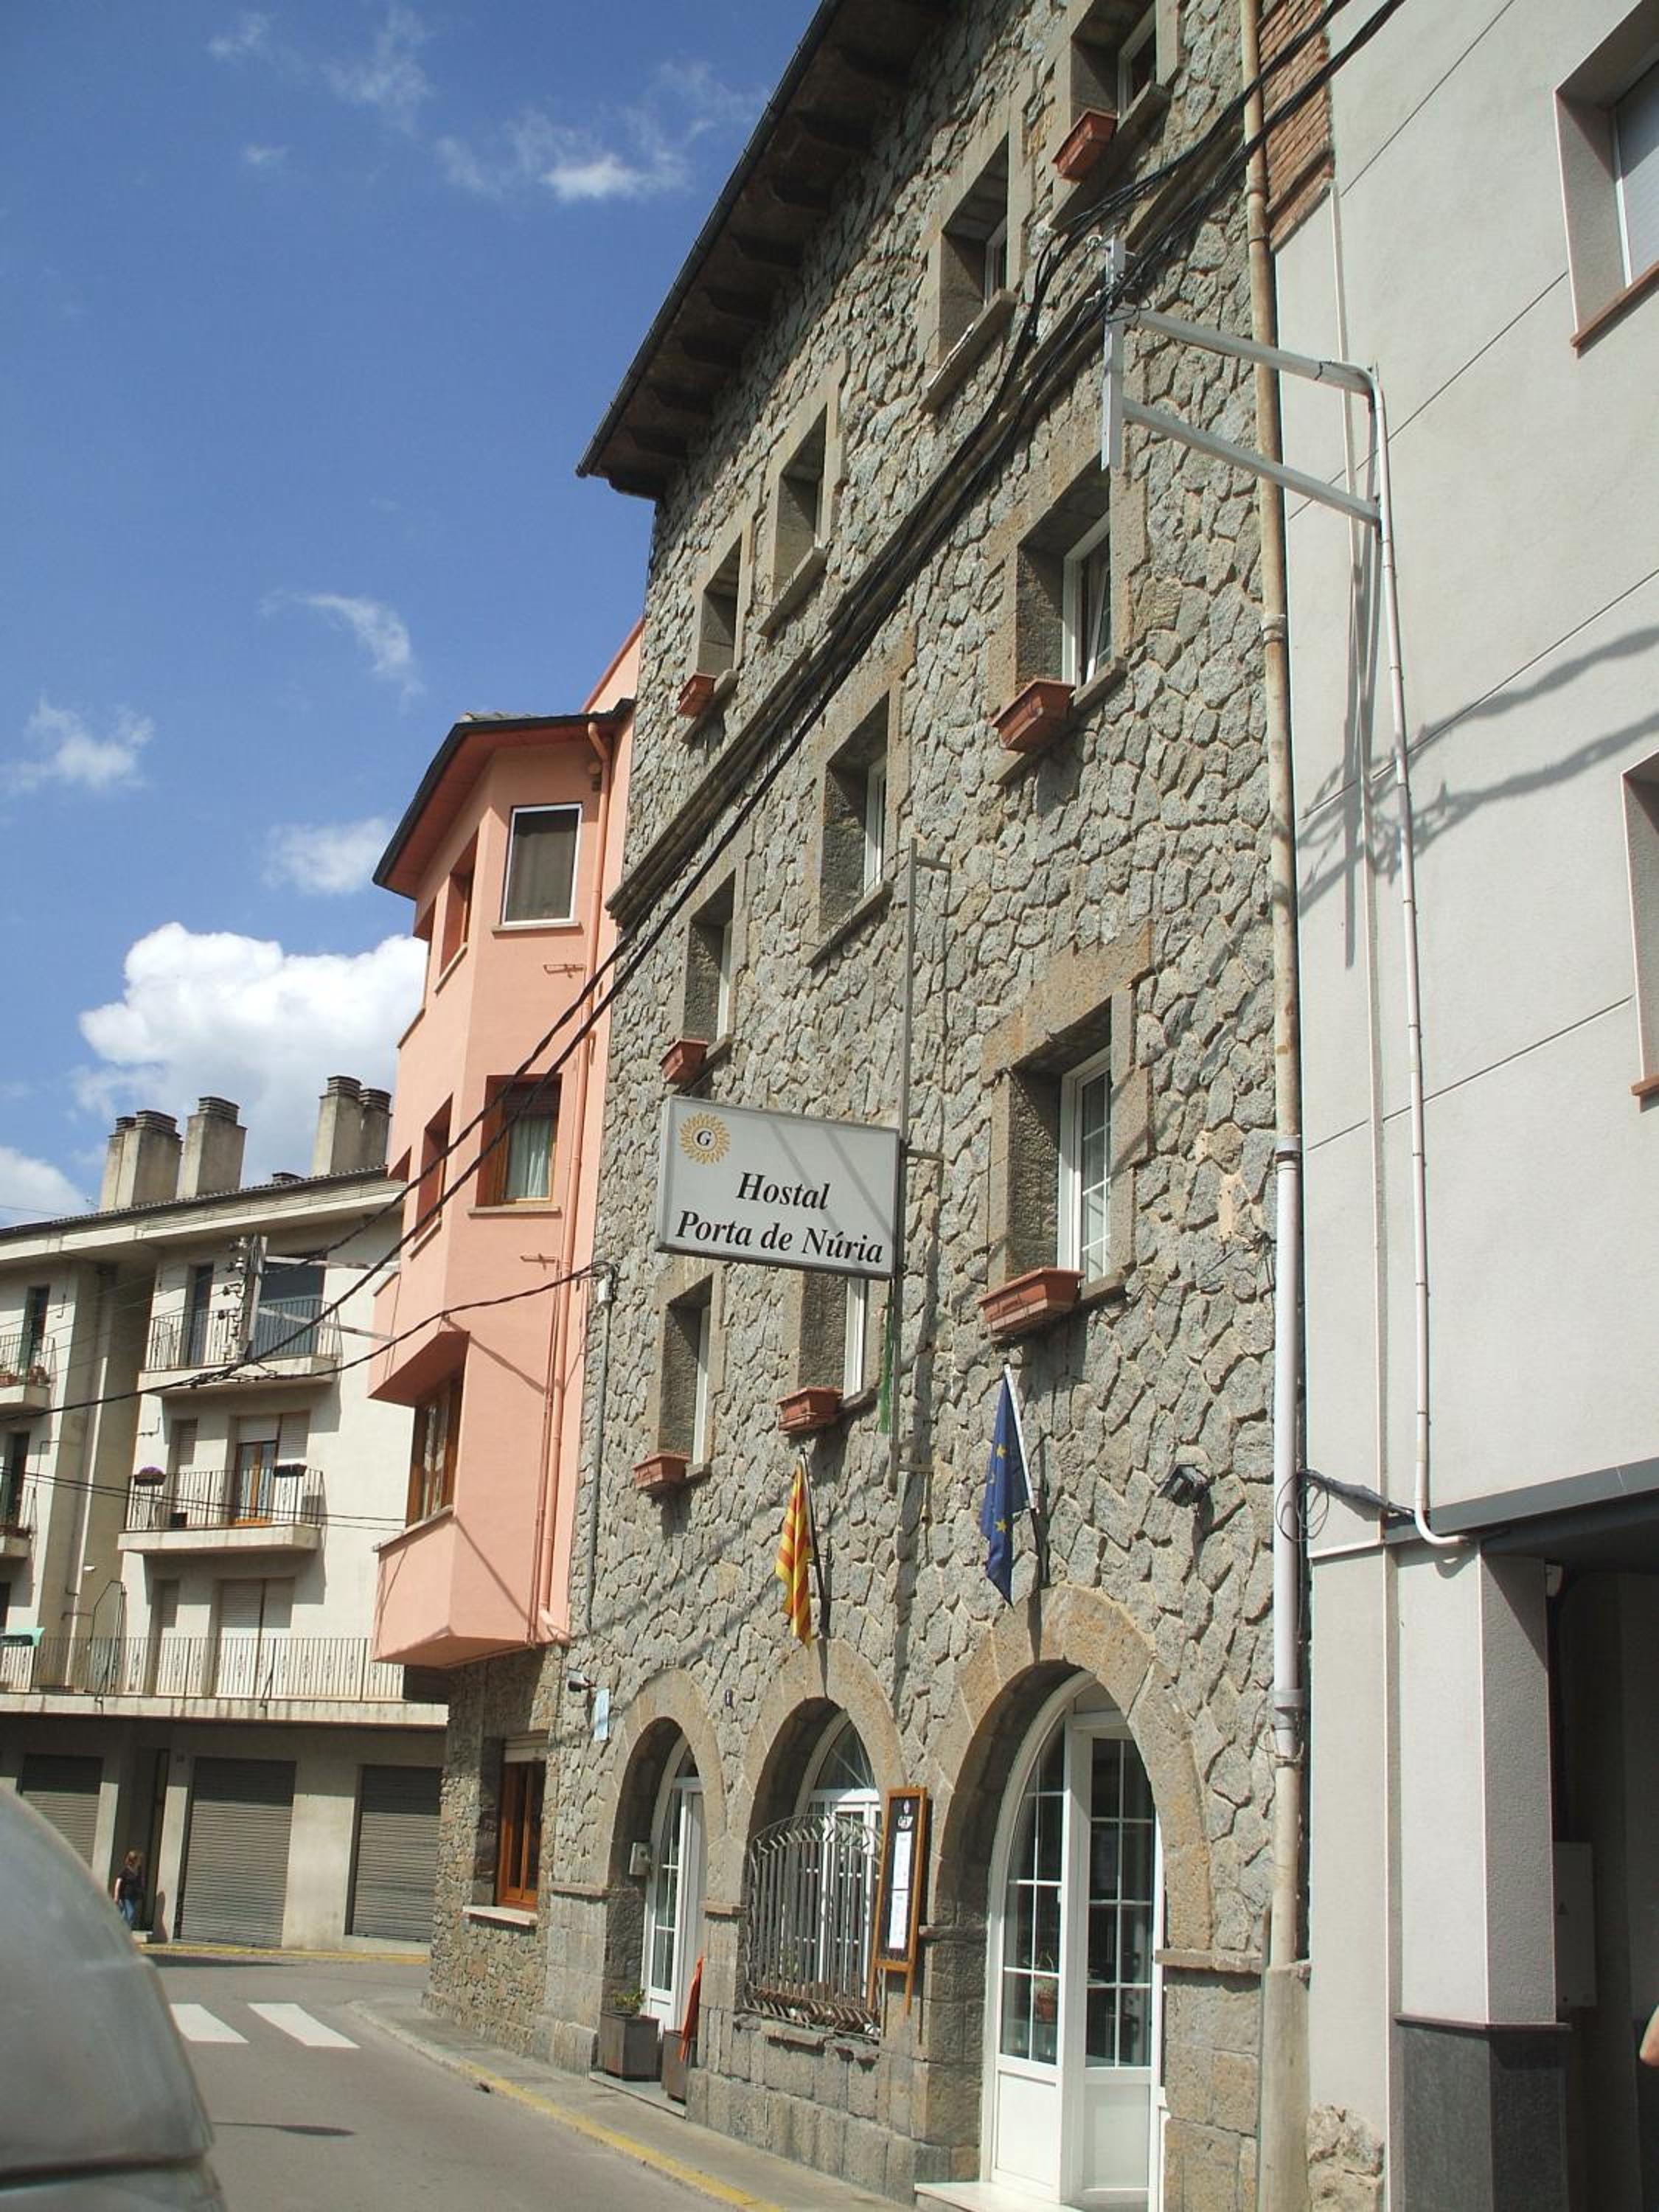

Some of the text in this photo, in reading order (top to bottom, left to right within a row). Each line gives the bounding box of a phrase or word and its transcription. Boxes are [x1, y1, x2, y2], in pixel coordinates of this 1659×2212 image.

[696, 1130, 712, 1146] G
[736, 1171, 831, 1210] Hostal
[675, 1210, 883, 1263] Porta de Núria
